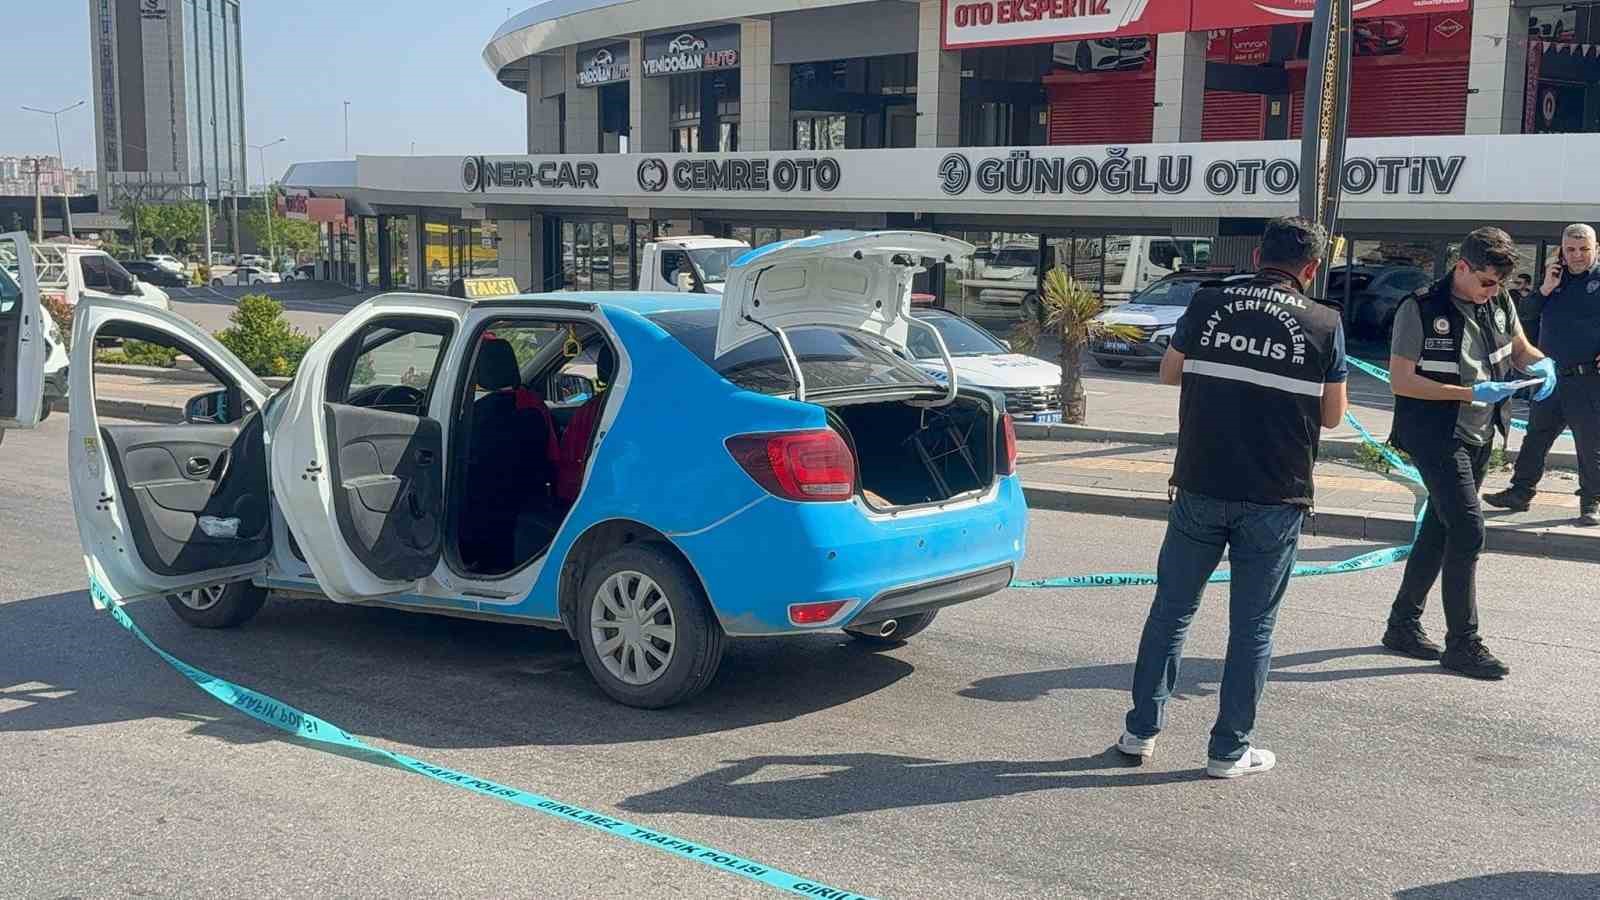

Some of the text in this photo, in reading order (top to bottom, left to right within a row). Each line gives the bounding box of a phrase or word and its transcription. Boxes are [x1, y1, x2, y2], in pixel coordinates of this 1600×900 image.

[954, 3, 994, 27] OTO
[704, 49, 738, 66] AUTO
[673, 157, 841, 191] CEMRE OTO
[976, 147, 1192, 195] GÜNOĞLU
[1200, 310, 1222, 346] OLAY
[1214, 332, 1287, 360] POLİS
[537, 800, 624, 829] GIRILMEZ
[630, 828, 701, 854] TRAFIK
[699, 850, 769, 877] POLISI
[793, 882, 866, 900] GIRIL
